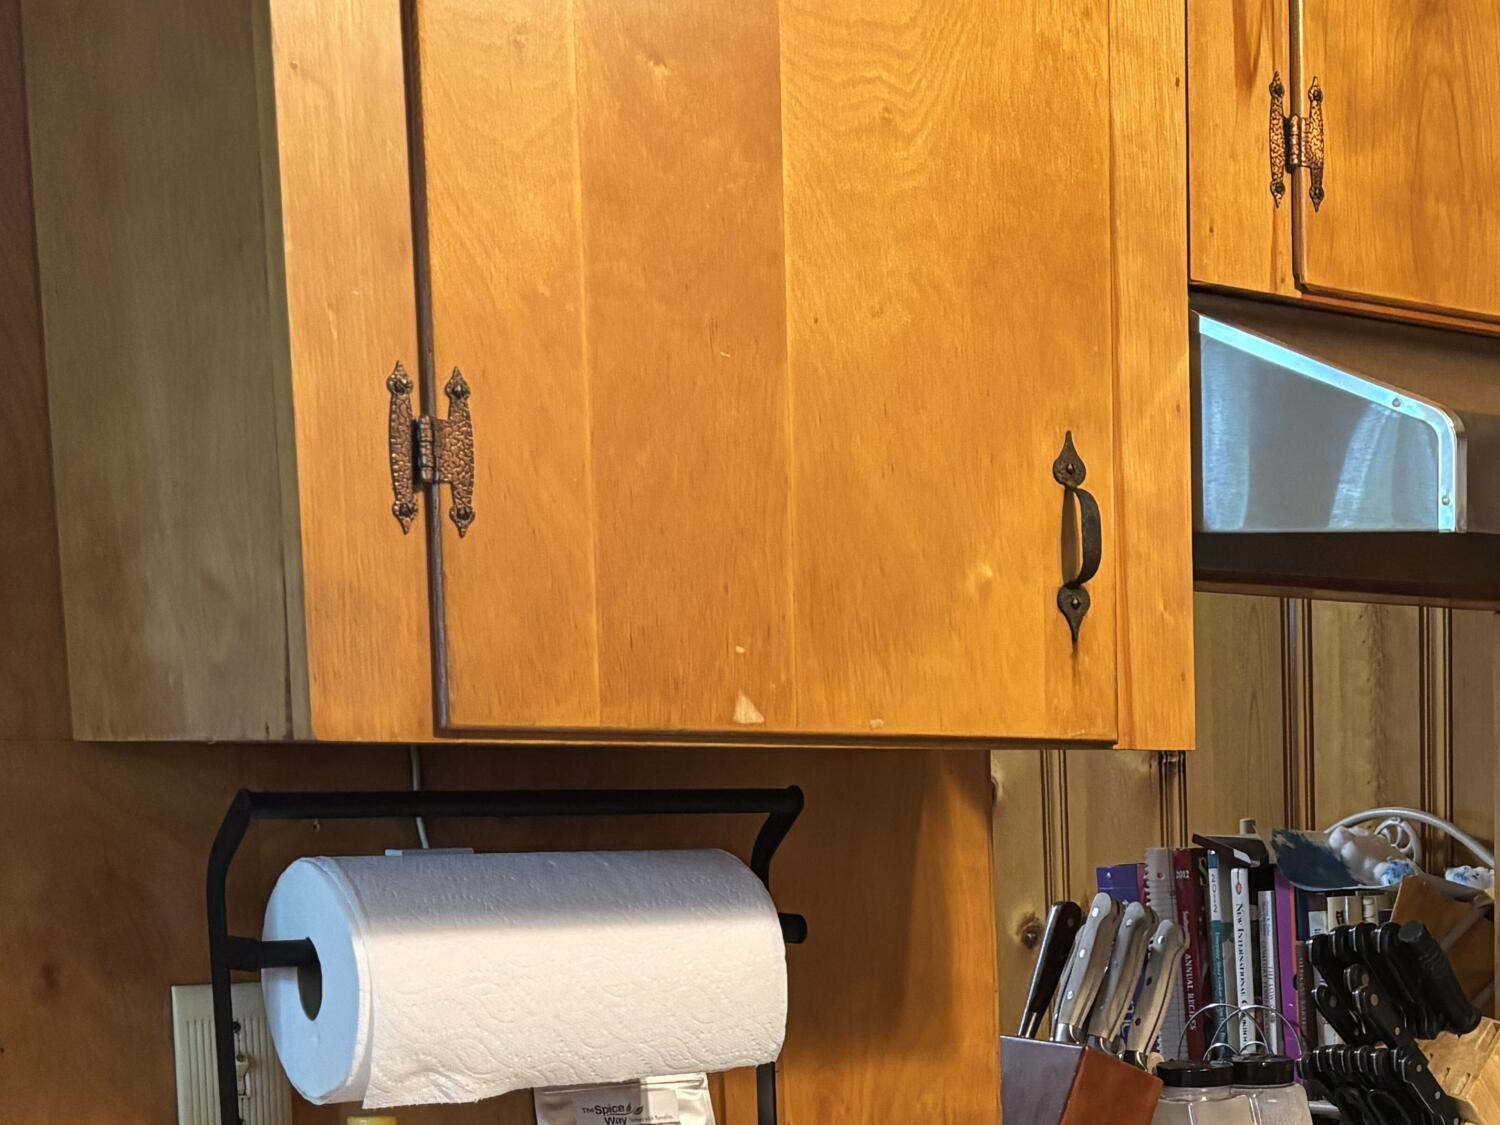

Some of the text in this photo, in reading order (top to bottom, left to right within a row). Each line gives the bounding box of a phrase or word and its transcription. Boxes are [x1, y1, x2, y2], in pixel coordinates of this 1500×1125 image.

[1184, 953, 1195, 990] ANNUAL
[594, 1104, 625, 1116] Spice
[604, 1116, 628, 1125] Way
